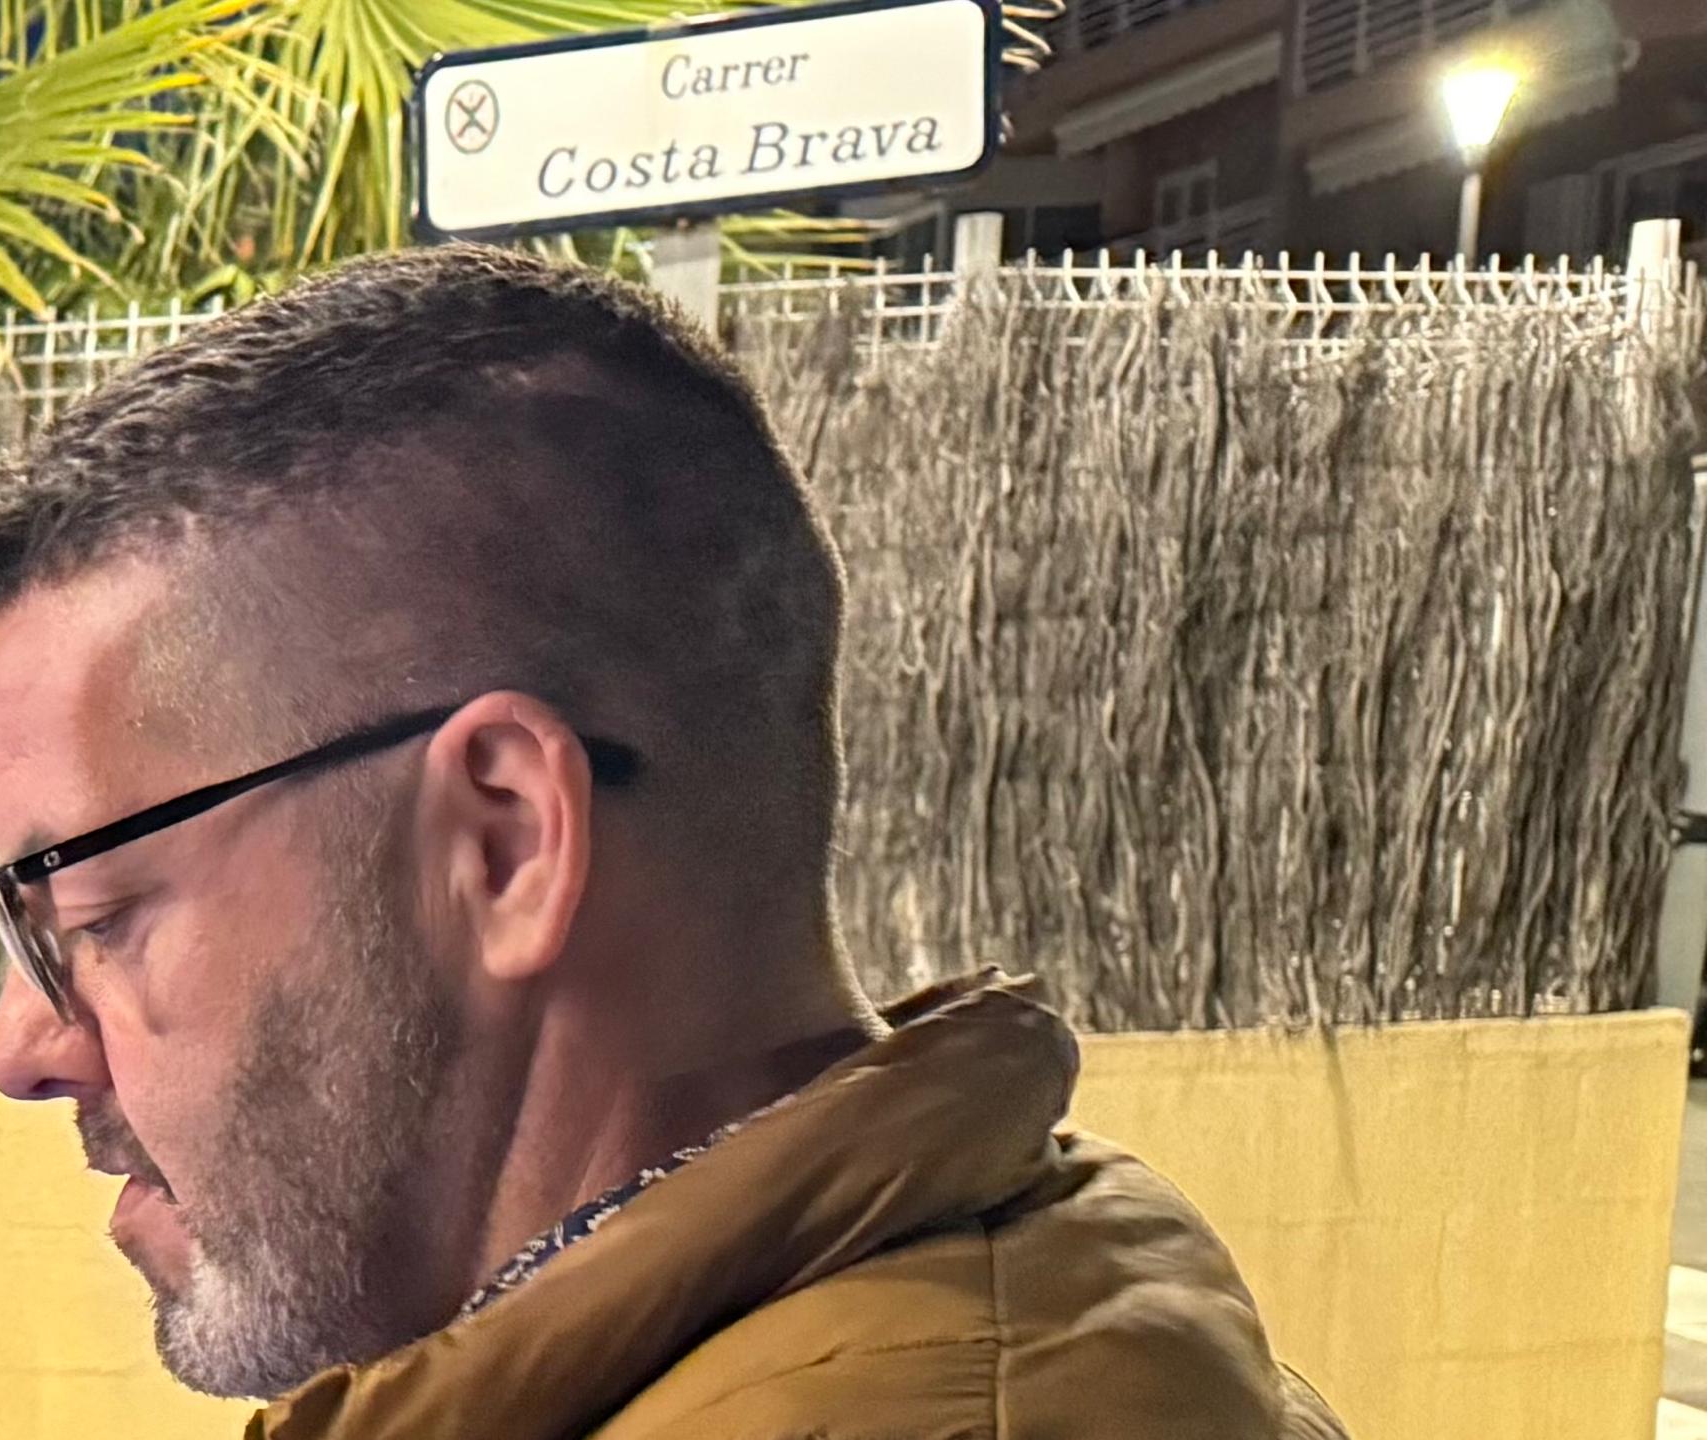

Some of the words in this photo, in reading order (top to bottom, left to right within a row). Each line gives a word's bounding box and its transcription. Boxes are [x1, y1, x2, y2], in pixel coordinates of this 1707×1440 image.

[661, 51, 810, 100] Carrer
[537, 139, 719, 199] Costa
[742, 115, 942, 176] Brava
